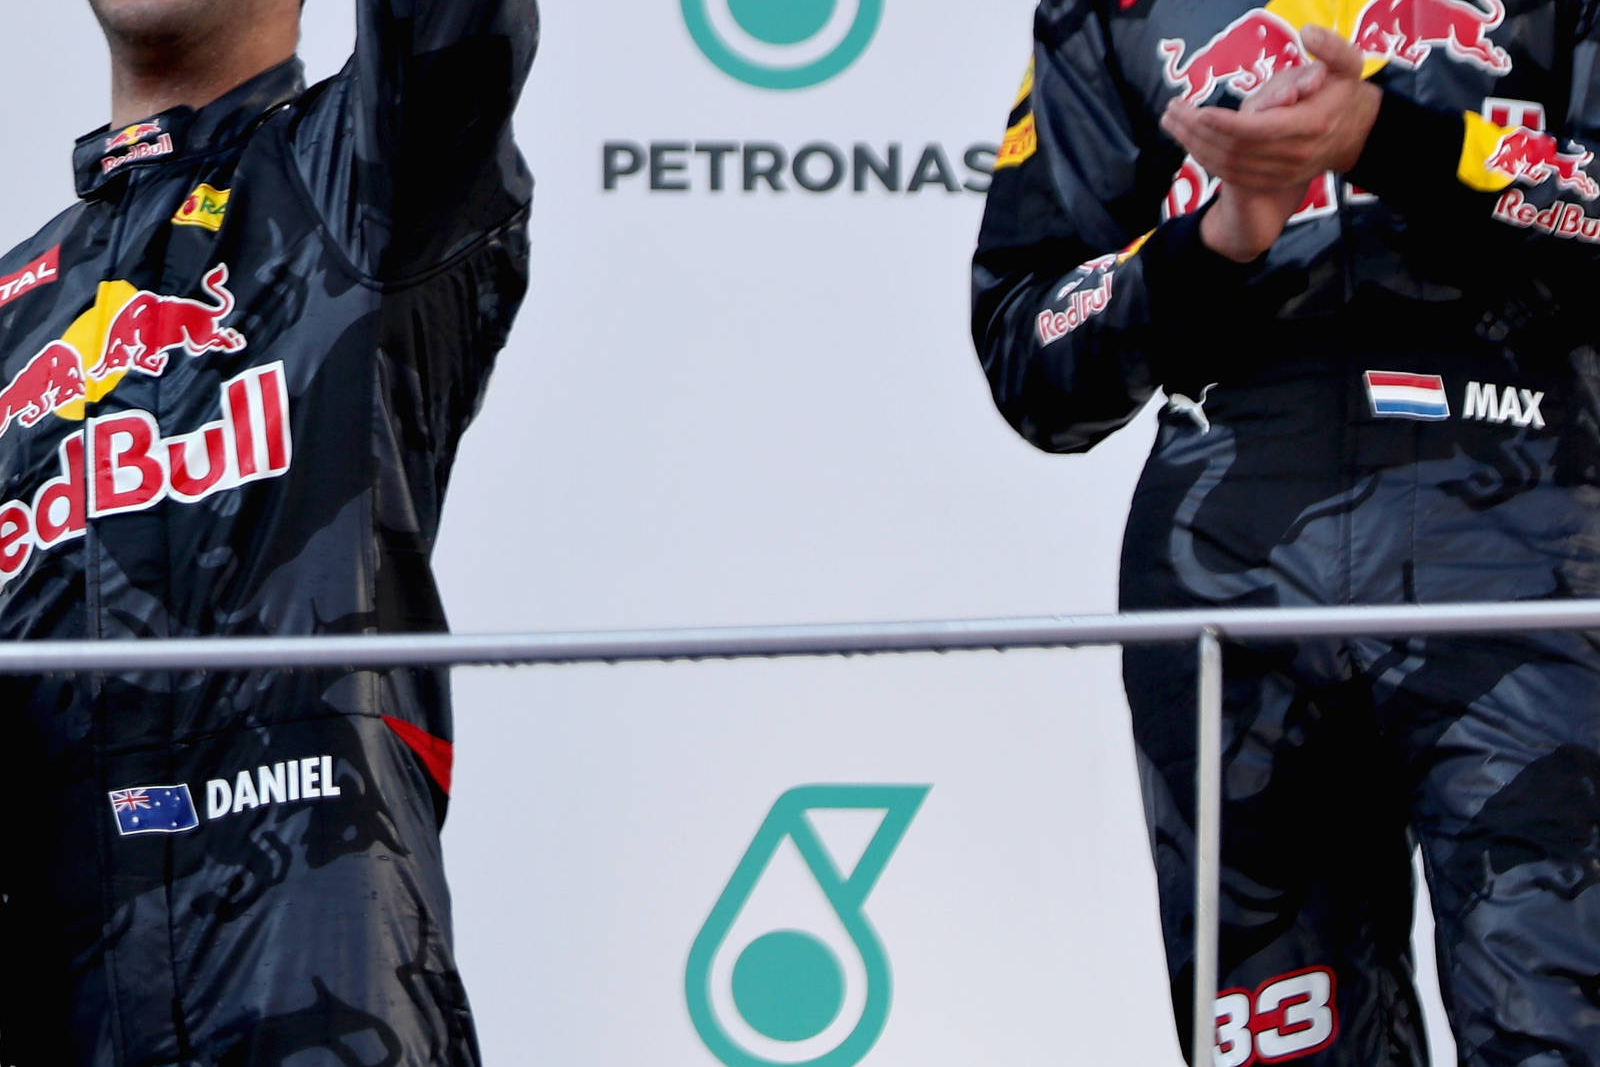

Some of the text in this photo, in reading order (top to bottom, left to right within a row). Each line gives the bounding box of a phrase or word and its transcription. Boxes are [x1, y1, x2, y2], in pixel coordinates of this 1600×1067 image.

[602, 140, 997, 193] PETRONAS
[1462, 380, 1547, 430] MAX
[205, 755, 342, 821] DANIEL
